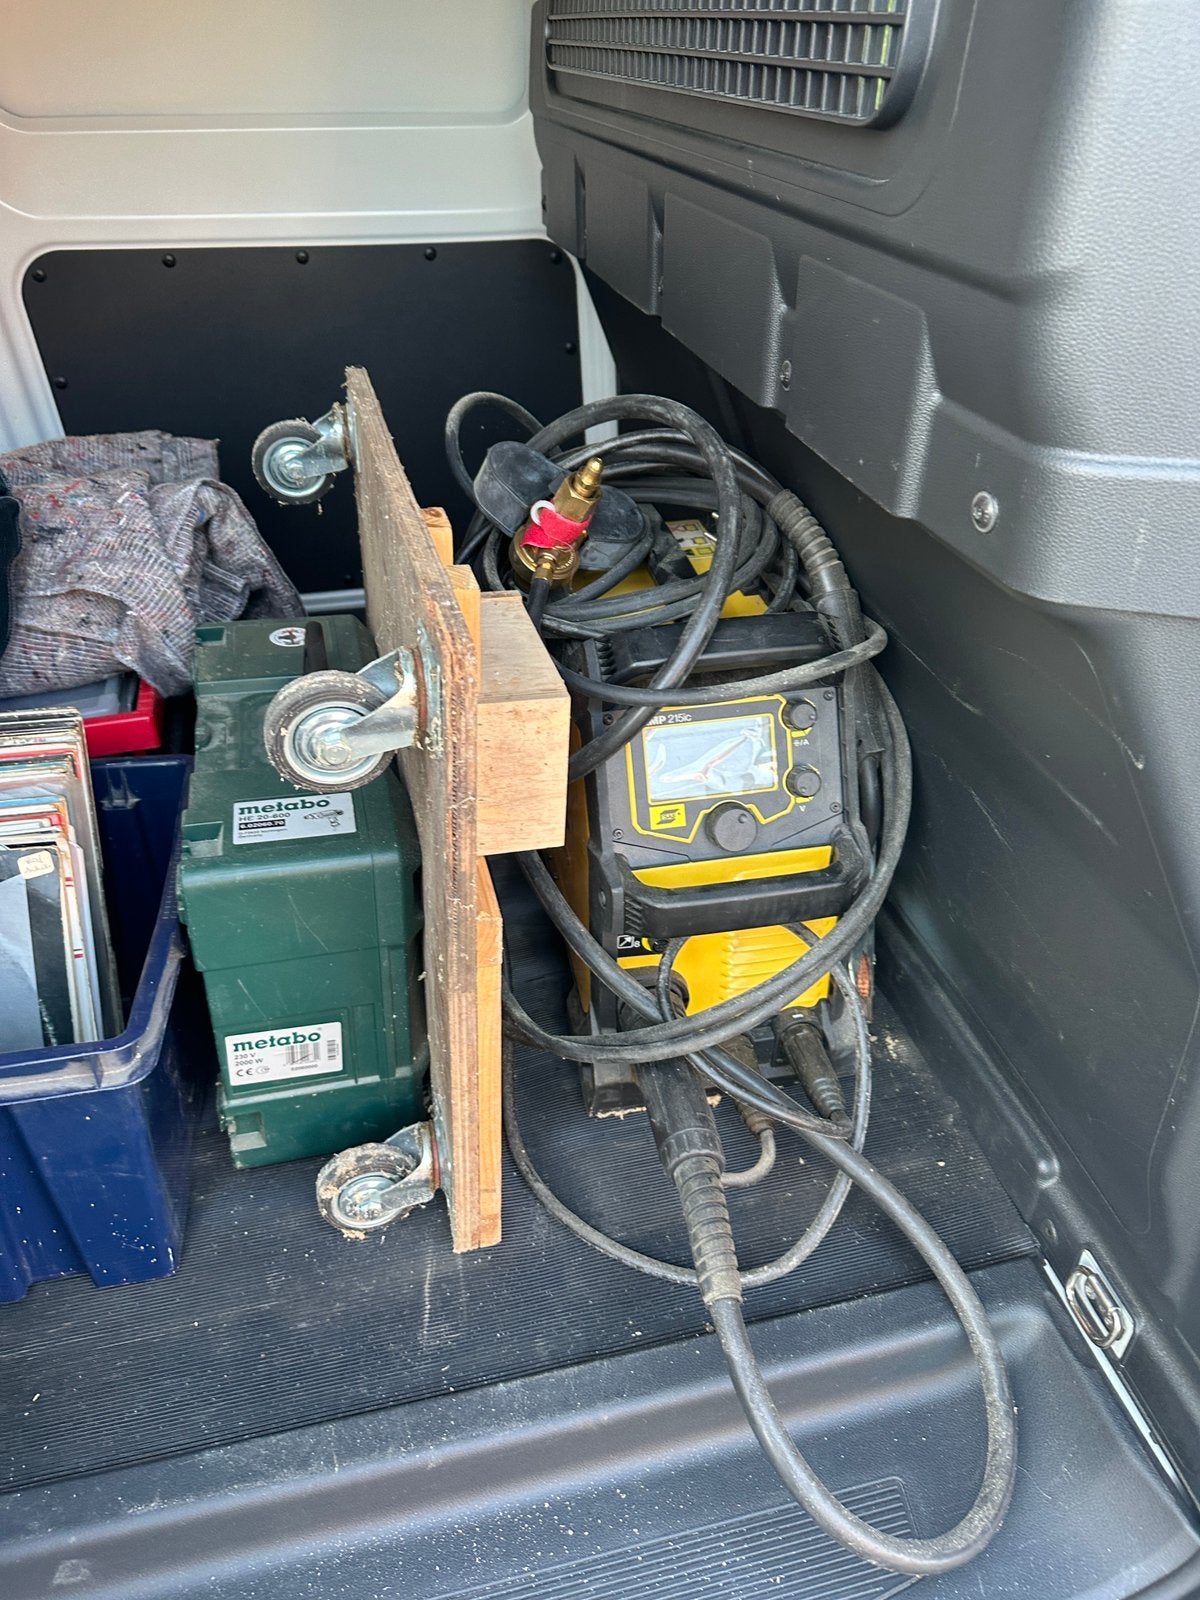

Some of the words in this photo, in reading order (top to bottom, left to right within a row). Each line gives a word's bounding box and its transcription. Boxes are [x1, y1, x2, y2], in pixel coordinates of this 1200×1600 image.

[646, 715, 667, 726] MP
[239, 799, 330, 815] metabo
[257, 812, 291, 820] 20-600
[233, 1031, 321, 1052] metabo
